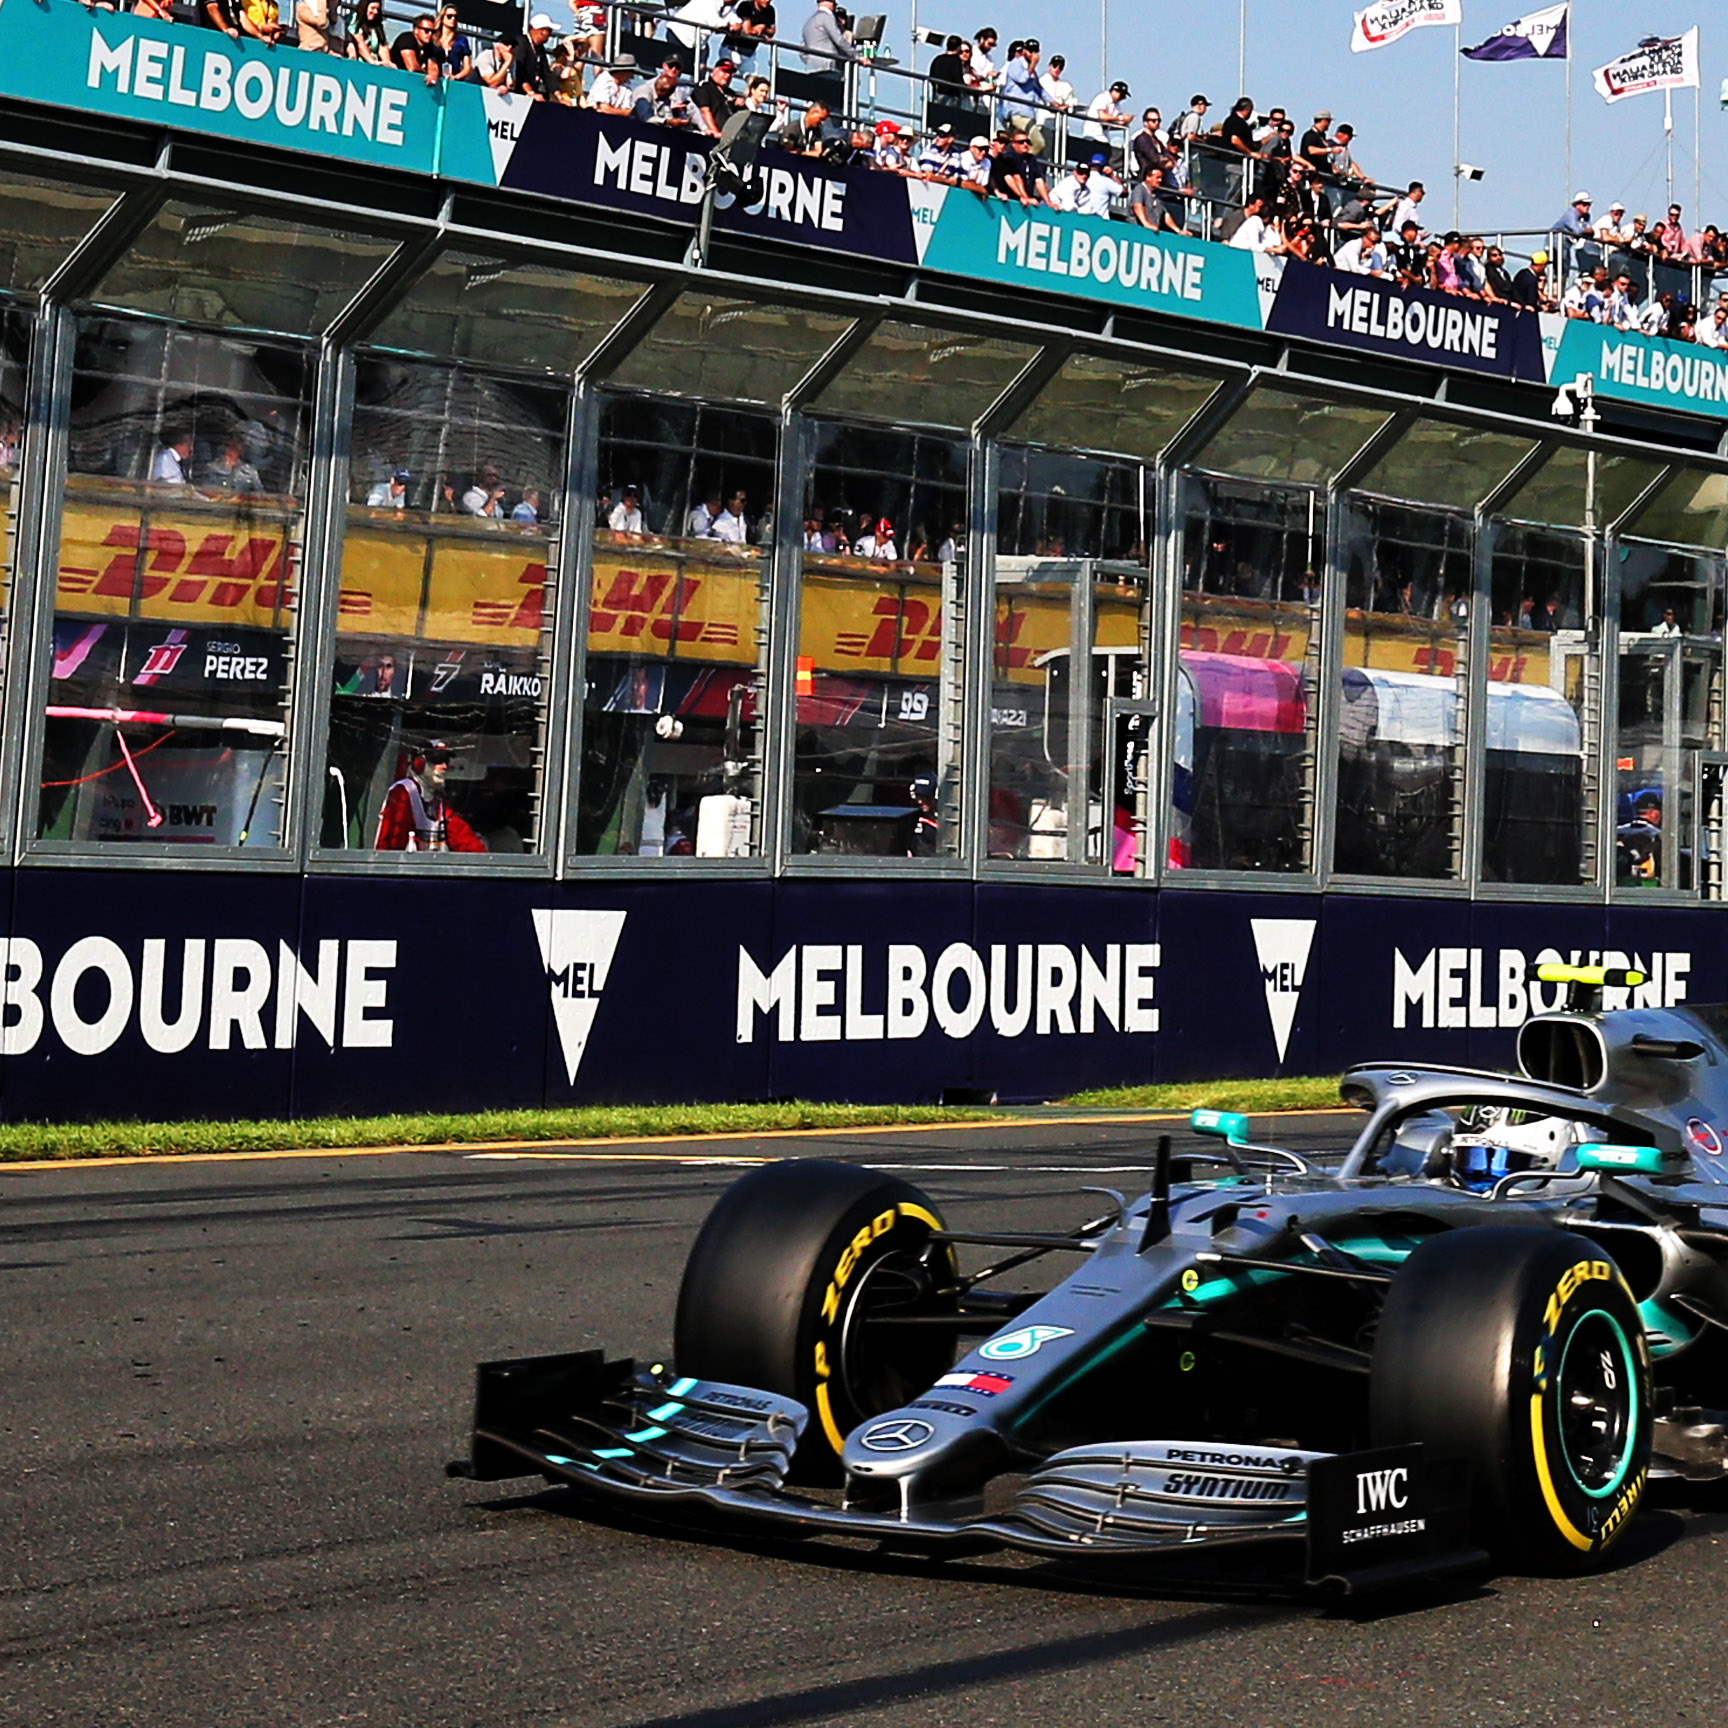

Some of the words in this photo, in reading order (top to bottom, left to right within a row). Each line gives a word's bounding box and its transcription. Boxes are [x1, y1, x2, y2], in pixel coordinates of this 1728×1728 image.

[86, 27, 408, 146] MELBOURNE
[487, 117, 520, 141] MEL
[911, 206, 936, 225] MEL
[997, 214, 1205, 301] MELBOURNE
[1327, 283, 1499, 359] MELBOURNE
[203, 654, 269, 680] PEREZ
[898, 691, 930, 721] 99
[168, 803, 218, 828] BWT
[547, 960, 605, 1000] MEL
[736, 942, 1161, 1044] MELBOURNE
[1260, 962, 1303, 996] MEL
[1392, 946, 1692, 1029] MELBORNE
[820, 1208, 895, 1328] ZERO
[1543, 1260, 1611, 1337] ZERO
[1166, 1448, 1282, 1469] PETRONA
[1162, 1472, 1291, 1500] SYNTIUM
[1356, 1467, 1409, 1514] IWC
[1342, 1518, 1426, 1544] SCHAFFHAUSEN
